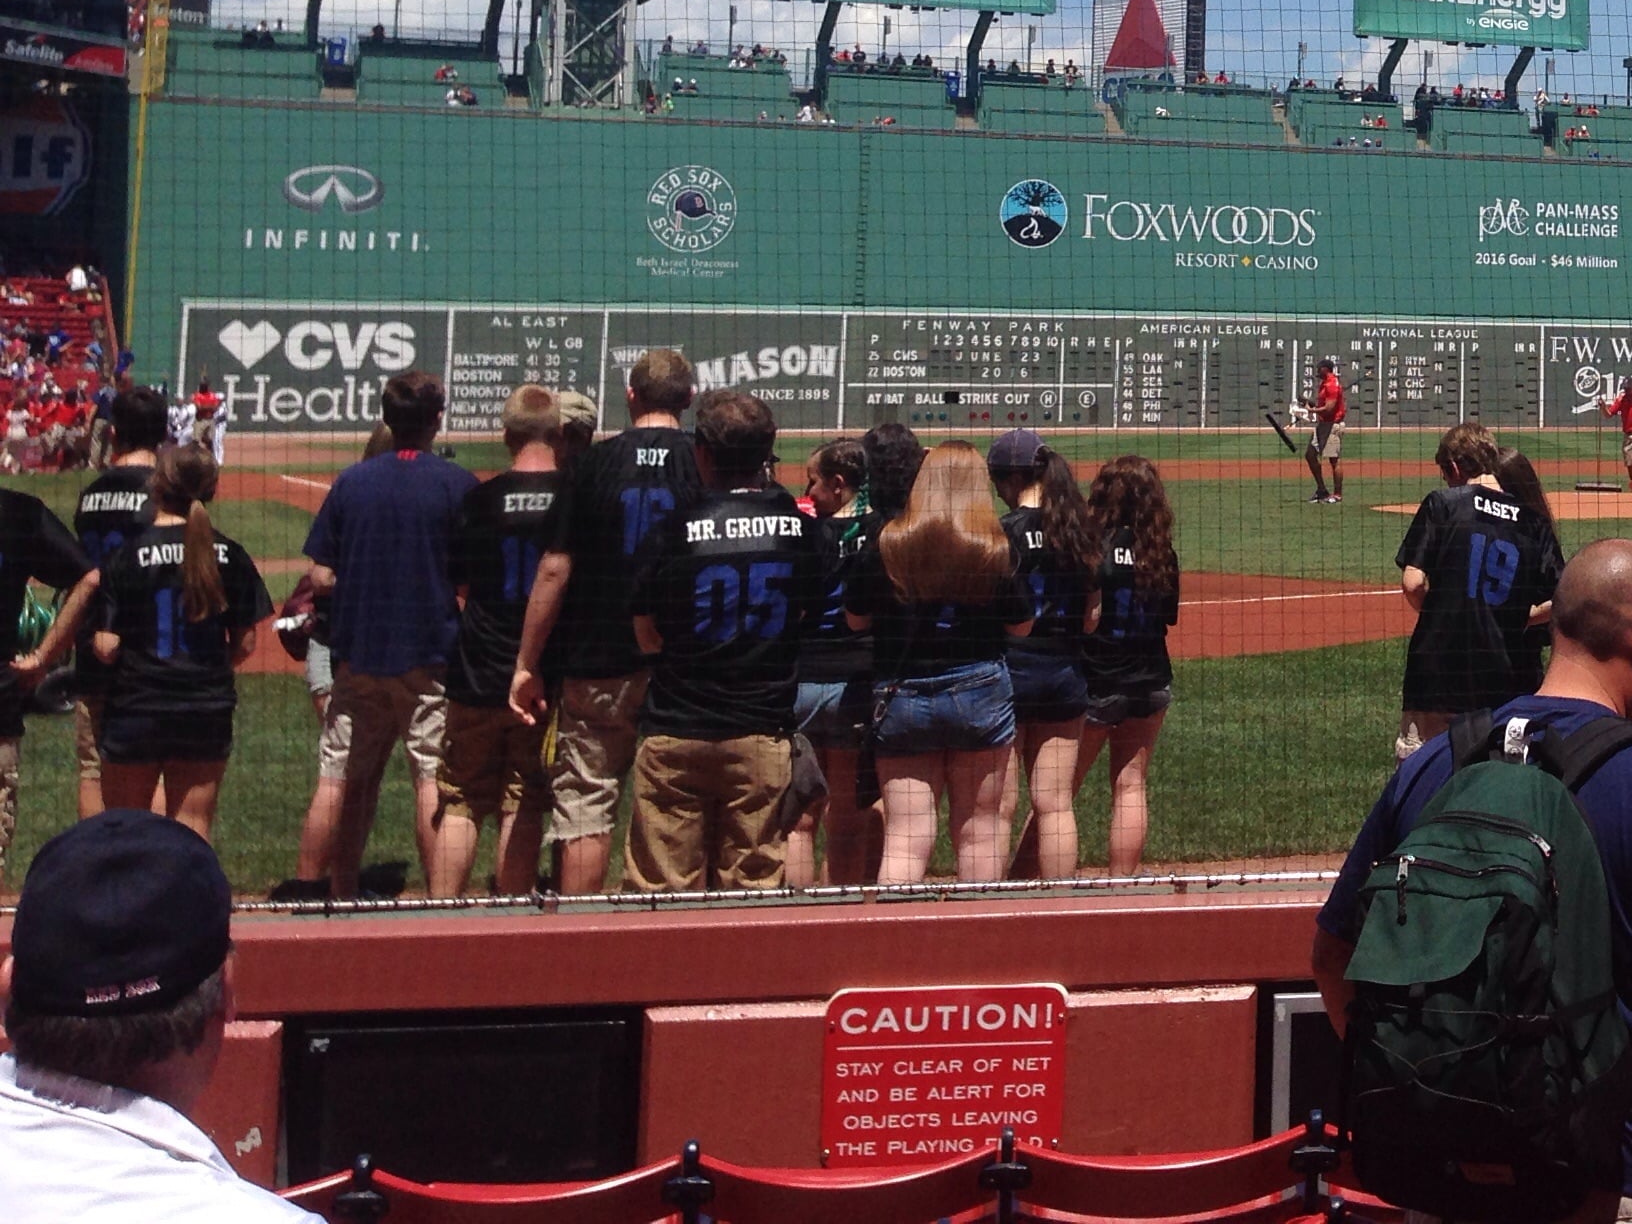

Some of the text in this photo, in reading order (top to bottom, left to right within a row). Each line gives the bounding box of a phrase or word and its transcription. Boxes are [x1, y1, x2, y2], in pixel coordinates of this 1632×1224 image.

[651, 169, 723, 206] RED SOX
[1536, 202, 1619, 221] PAN-MASS
[653, 201, 732, 249] SCHOLARS
[1081, 193, 1318, 246] FOXWOODS
[1535, 222, 1618, 238] CHALLENGE
[244, 228, 420, 252] INFINITI
[636, 257, 658, 268] Beth
[660, 257, 687, 268] Israel
[1174, 253, 1318, 271] RESORT CASINO
[1475, 252, 1618, 269] 2016 Goal $46 Million
[651, 267, 725, 278] Medical Center
[491, 316, 568, 327] AL EAST
[902, 320, 1065, 332] FENWAY PARK
[1139, 323, 1269, 335] AMERICAN LEAGUE
[1362, 327, 1479, 339] NATIONAL LEAGUE
[284, 320, 416, 371] CVS
[525, 337, 583, 349] W L GB
[1047, 337, 1059, 347] 10
[454, 353, 519, 366] BALTIMORE
[545, 353, 561, 366] 30
[892, 350, 918, 361] CWS
[1142, 352, 1164, 363] OAK
[1405, 356, 1427, 366] NYM
[695, 344, 840, 392] MASON
[1142, 364, 1163, 375] LAA
[1406, 367, 1424, 377] ATL
[453, 369, 502, 382] BOSTON
[544, 370, 561, 382] 32
[1142, 376, 1163, 387] SEA
[1405, 378, 1426, 388] CHC
[453, 385, 512, 398] TORONTO
[750, 388, 831, 401] SINCE 1898
[1141, 388, 1162, 399] DET
[1406, 390, 1423, 400] MIA
[866, 393, 881, 405] AT
[915, 393, 946, 405] BALL
[959, 393, 999, 405] STRIKE
[1004, 394, 1030, 405] OUT
[1143, 400, 1161, 411] PHI
[451, 402, 477, 415] NEW
[451, 417, 489, 430] TAMPA
[1142, 412, 1161, 423] MIN
[636, 448, 669, 467] ROY
[1474, 495, 1520, 522] CASEY
[686, 516, 803, 542] MR. GROVER
[138, 543, 229, 567] CAOUE
[1467, 532, 1520, 606] 19
[693, 562, 794, 643] 05
[840, 1003, 1053, 1035] CAUTION!
[836, 1056, 1052, 1078] STAY CLEAR OF NET
[837, 1083, 1046, 1104] AND BE ALERT FOR
[843, 1110, 1038, 1130] OBJECTS LEAVING
[836, 1138, 975, 1157] THE PLAYING
